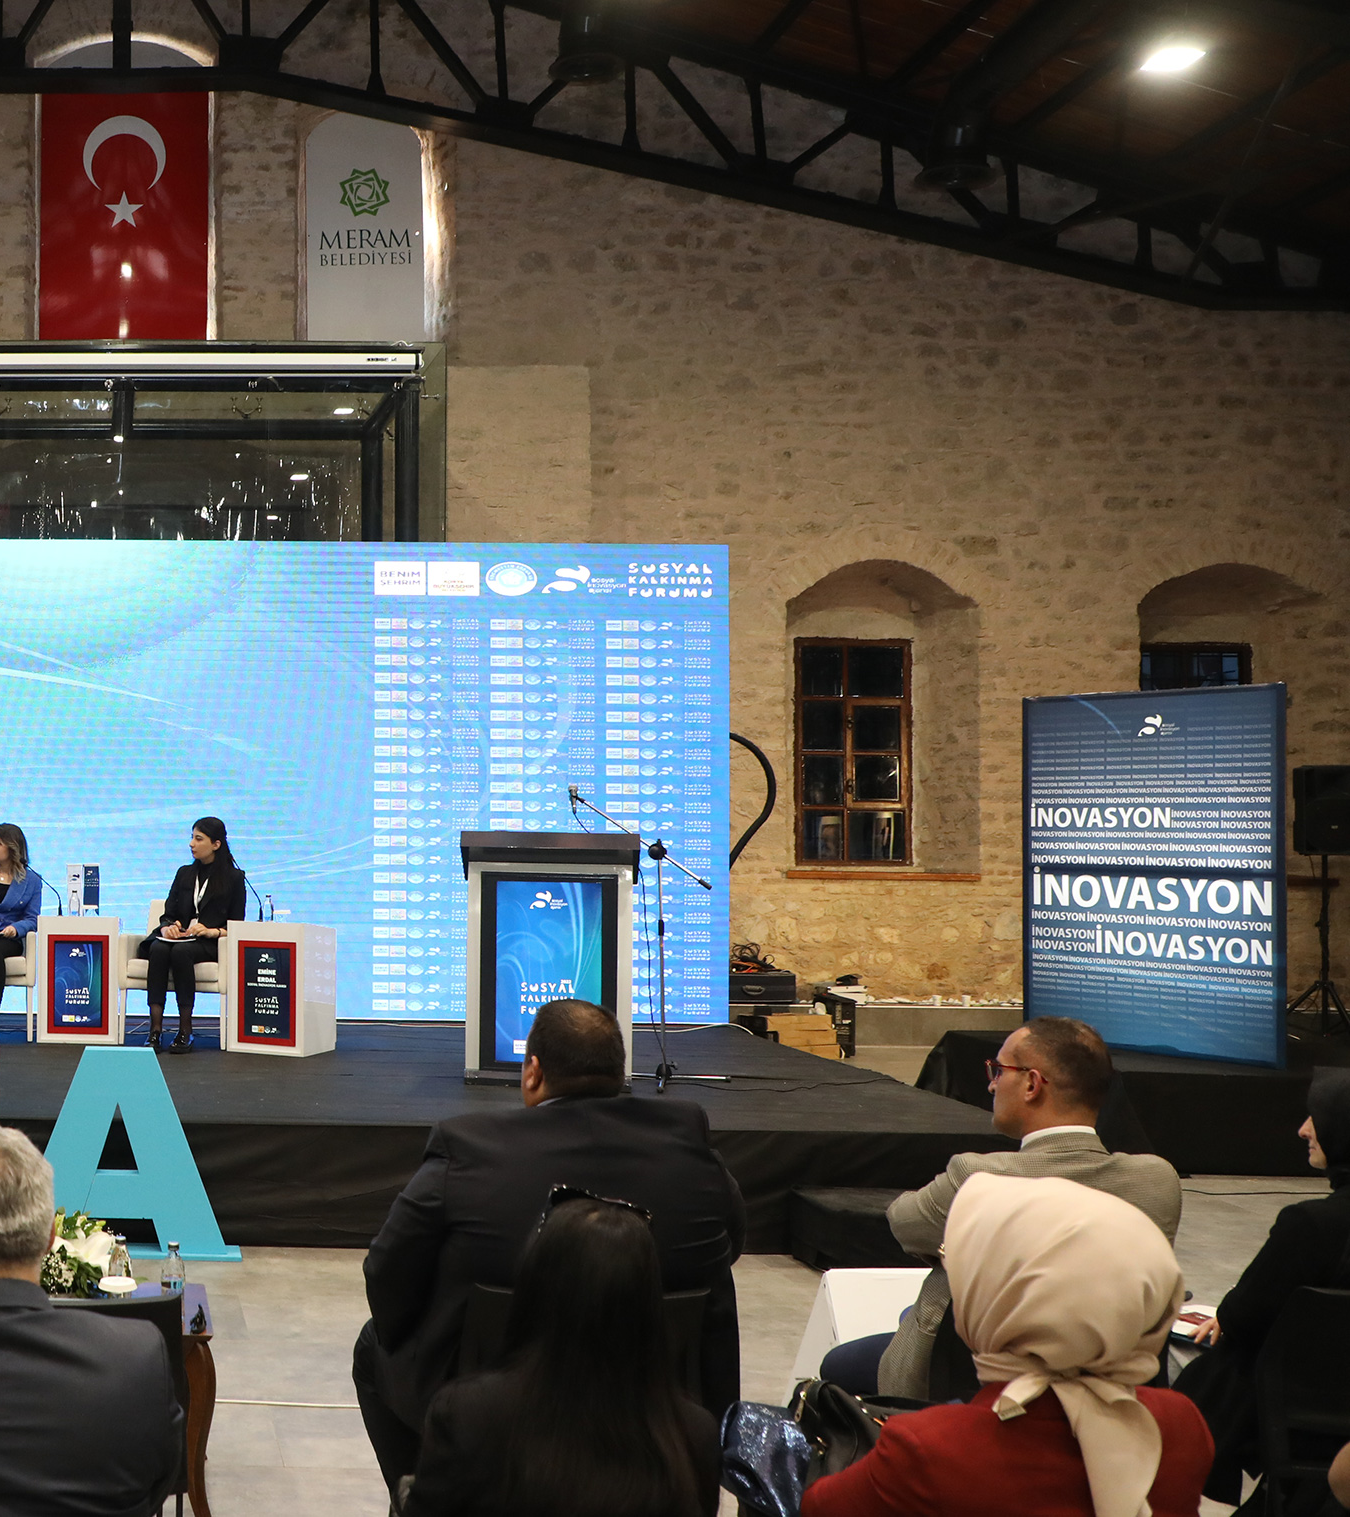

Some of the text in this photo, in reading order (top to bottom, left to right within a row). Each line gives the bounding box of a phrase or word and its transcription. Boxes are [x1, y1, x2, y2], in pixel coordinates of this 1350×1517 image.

[320, 229, 411, 250] MERAM
[320, 250, 411, 266] BELEDİYESİ
[628, 576, 713, 585] KALKINMA
[628, 588, 713, 598] FORUMU
[1031, 803, 1170, 828] İNOVASYON
[1171, 809, 1271, 818] İNOVASYON İNOVASYON
[1171, 820, 1271, 828] İNOVASYON İNOVASYON
[1032, 841, 1271, 853] İNOVASYON İNOVASYON İNOVASYON İNOVASYON İNOVASYON
[1032, 853, 1271, 869] İNOVASYON İNOVASYON İNOVASYON İNOVASYON
[1033, 866, 1272, 916] İNOVASYON
[1032, 909, 1271, 932] İNOVASYON İNOVASYON İNOVASYON İNOVASYON
[1032, 924, 1095, 939] İNOVASYON
[1032, 937, 1095, 952] İNOVASYON
[1096, 924, 1272, 965] İNOVASYON
